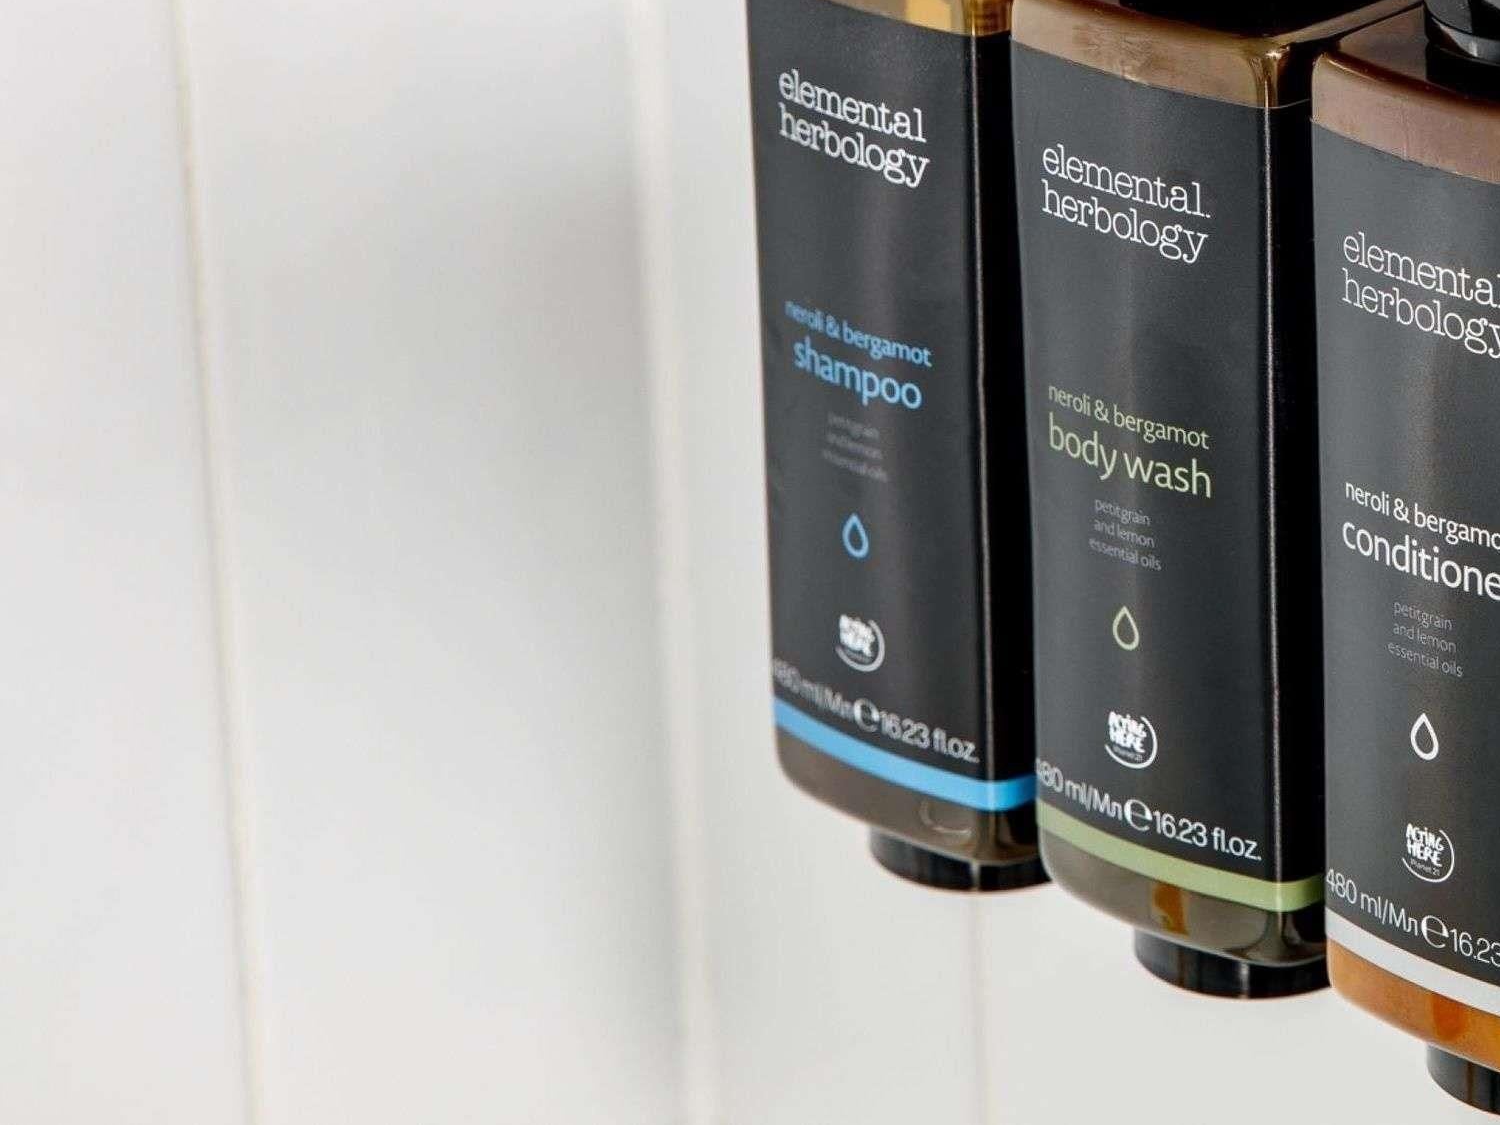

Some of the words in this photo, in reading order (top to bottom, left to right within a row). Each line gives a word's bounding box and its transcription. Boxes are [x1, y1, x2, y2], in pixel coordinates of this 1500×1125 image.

[779, 68, 927, 143] elemental
[779, 102, 931, 189] herbology
[1042, 143, 1207, 218] elemental
[1041, 178, 1209, 264] herbology
[784, 300, 826, 332] neroli
[826, 318, 840, 339] &
[842, 319, 933, 367] bergamot
[793, 335, 923, 410] shampoo
[1048, 384, 1091, 417] neroli
[1094, 399, 1110, 423] &
[1112, 403, 1211, 450] bergamot
[1049, 411, 1118, 481] body
[1123, 451, 1212, 499] wash
[1094, 520, 1115, 537] and
[1117, 524, 1155, 548] lemon
[1345, 481, 1390, 516] neroli
[1393, 498, 1411, 524] &
[1088, 537, 1139, 564] essential
[1140, 554, 1162, 571] oils
[1387, 641, 1439, 670] essential
[1441, 659, 1463, 678] oils
[1393, 623, 1414, 640] and
[1417, 629, 1457, 654] lemon
[1325, 868, 1358, 905] 480
